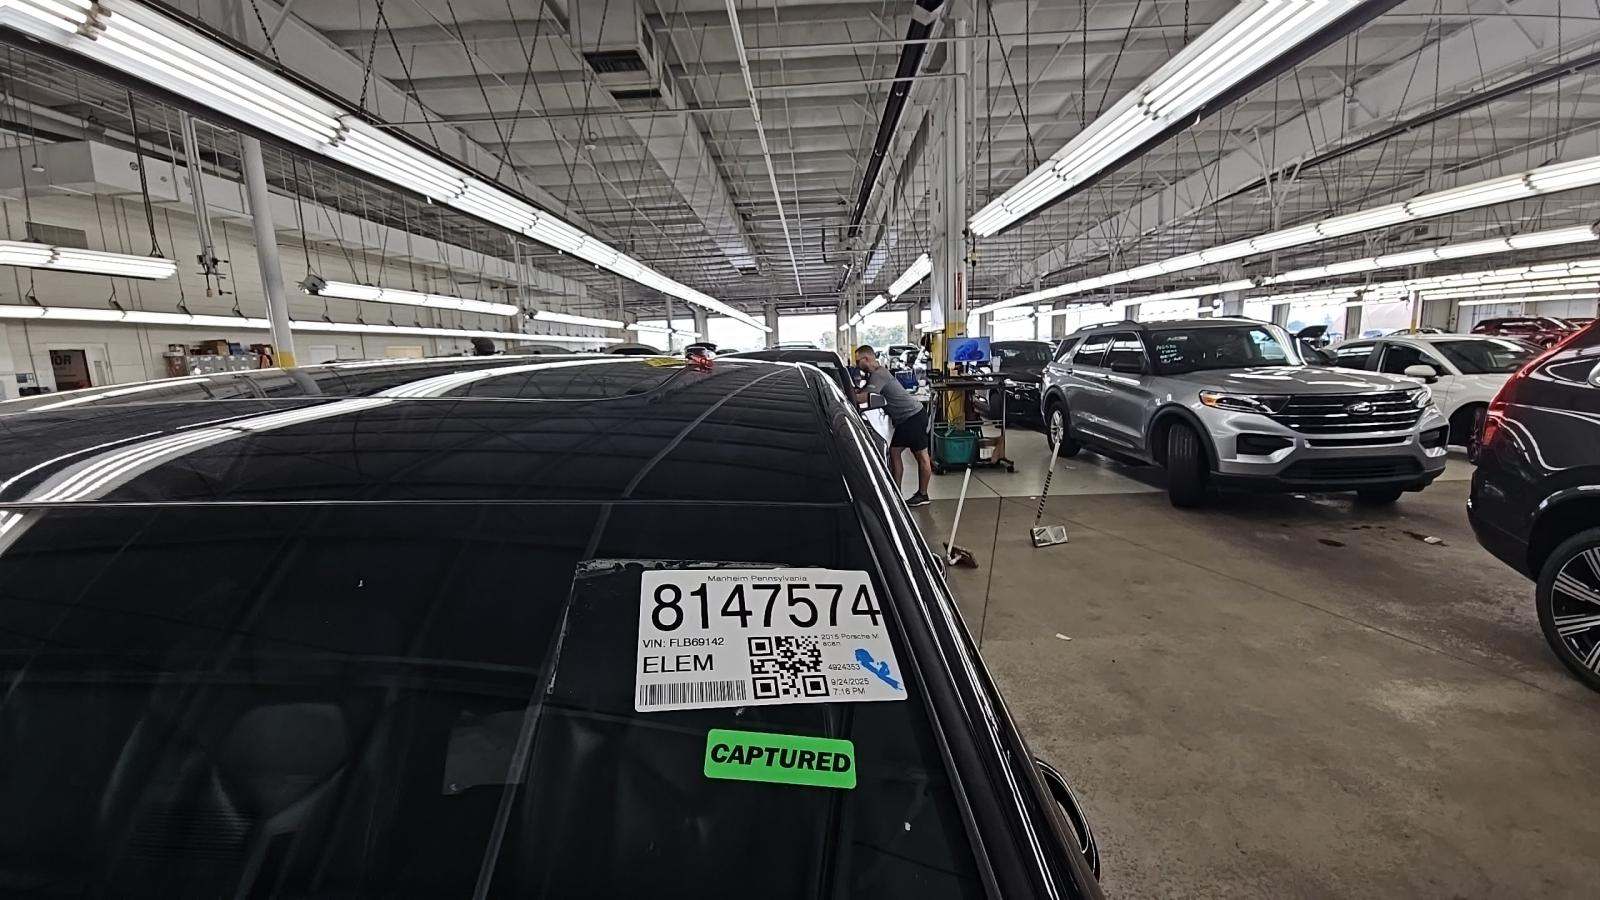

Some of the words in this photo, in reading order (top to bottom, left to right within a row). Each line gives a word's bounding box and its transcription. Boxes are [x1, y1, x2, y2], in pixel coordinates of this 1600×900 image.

[750, 575, 807, 583] Pennsylvania
[651, 582, 881, 632] 8147574
[642, 639, 666, 649] VIN:
[669, 637, 725, 648] FLB69142
[821, 633, 840, 641] 2015
[643, 653, 714, 674] ELEM
[831, 677, 870, 686] 9/24/2025
[710, 743, 852, 773] CAPTURED
